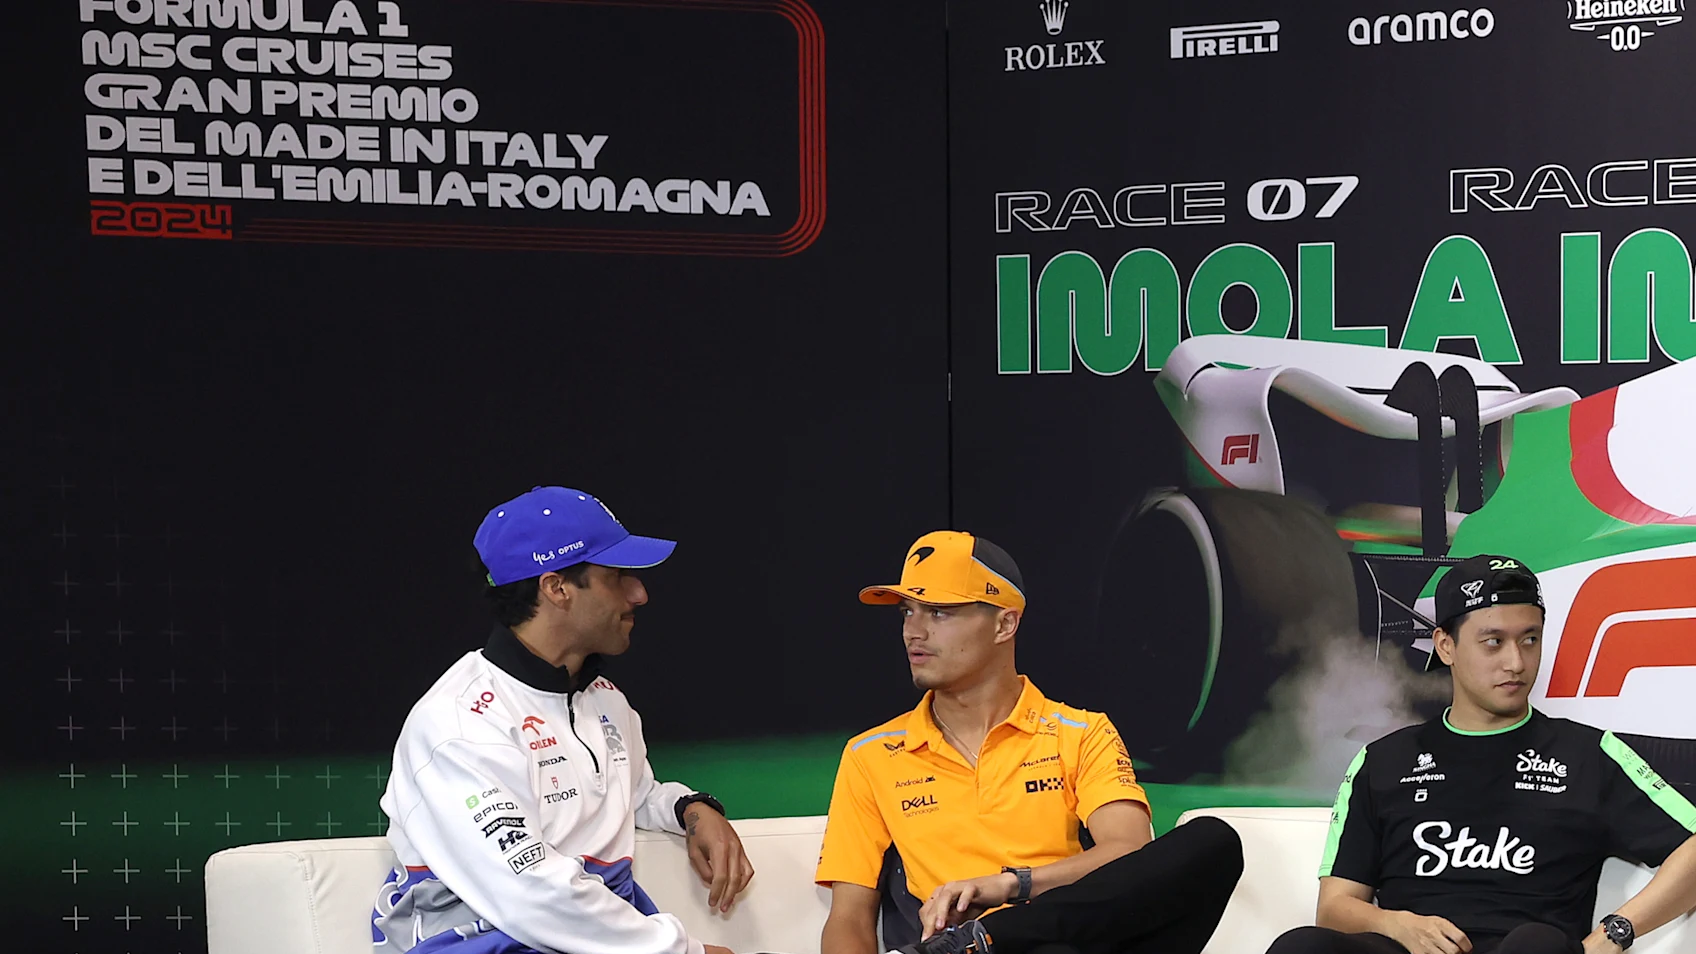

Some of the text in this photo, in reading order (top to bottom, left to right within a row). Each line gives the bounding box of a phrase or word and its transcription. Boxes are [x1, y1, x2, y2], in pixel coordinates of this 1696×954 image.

[79, 0, 409, 37] FORMULA 1
[1348, 8, 1495, 46] aramco
[82, 30, 453, 80] MSC CRUISES
[1004, 40, 1106, 72] ROLEX
[1170, 20, 1281, 59] PIRELLI
[84, 73, 479, 123] GRAN PREMIO
[85, 114, 609, 169] DEL MADE IN ITALY
[88, 157, 771, 216] E DELL'EMILIA-ROMAGNA
[92, 201, 232, 239] 2024
[995, 182, 1226, 232] RACE
[996, 234, 1523, 375] IMOLA
[1221, 433, 1260, 465] F1
[558, 540, 584, 554] OPTUS
[1489, 560, 1519, 570] 24
[1516, 749, 1567, 777] Stake
[544, 788, 578, 804] TUDOR
[895, 777, 923, 788] Android
[901, 795, 938, 811] DELL
[513, 846, 542, 869] NEFT
[1413, 821, 1535, 876] Stake
